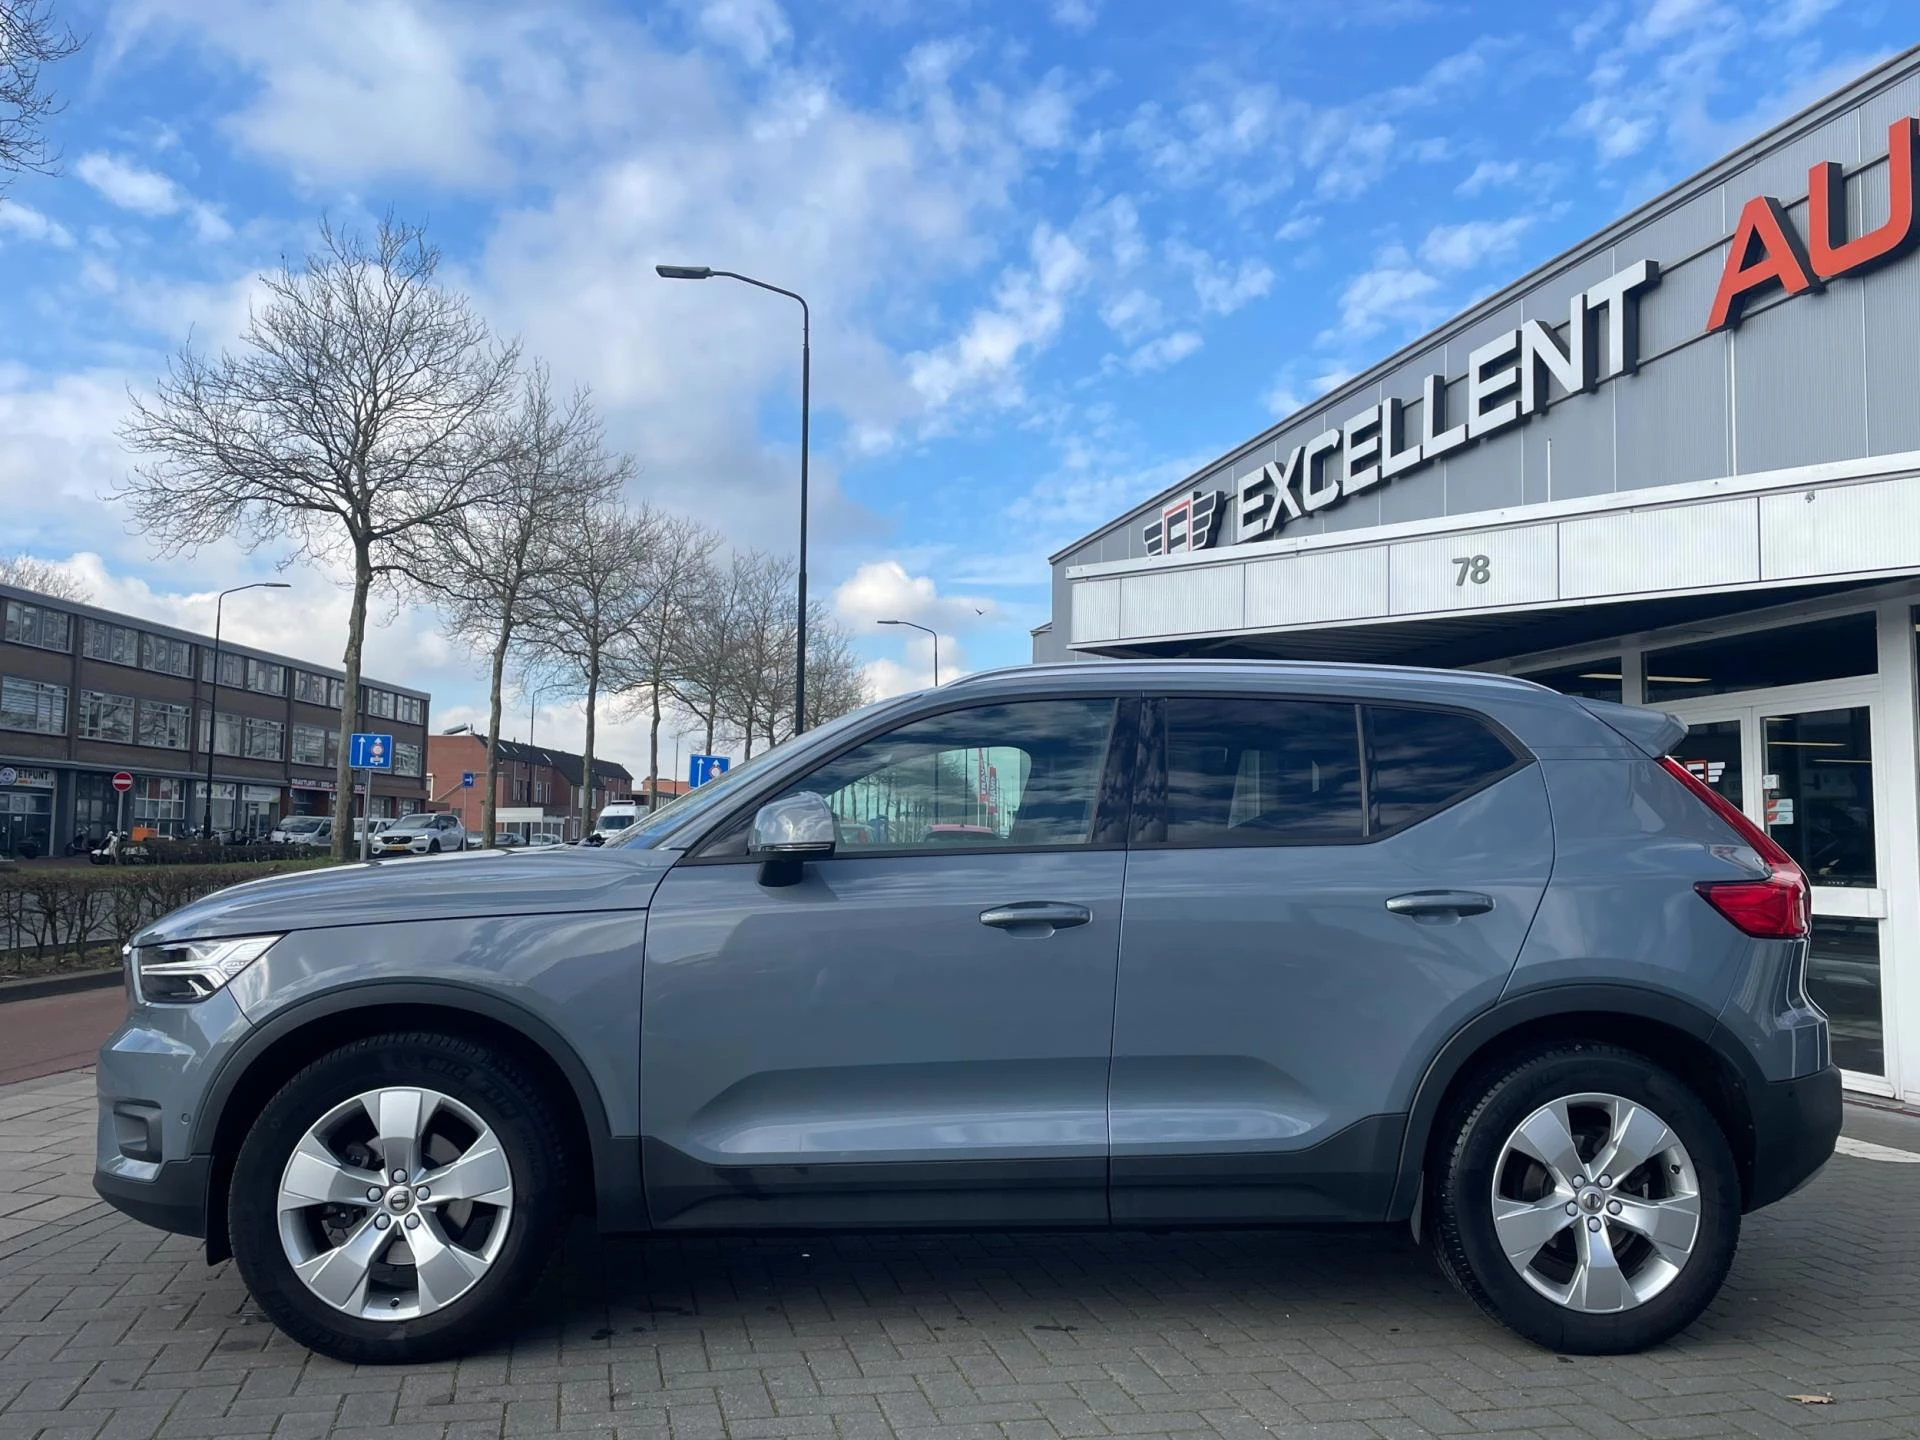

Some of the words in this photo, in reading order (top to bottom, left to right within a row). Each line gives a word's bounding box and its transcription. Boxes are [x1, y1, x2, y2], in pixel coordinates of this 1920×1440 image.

[1237, 260, 1652, 543] EXCELLENT
[1706, 115, 1920, 332] AU
[1452, 554, 1490, 586] 78
